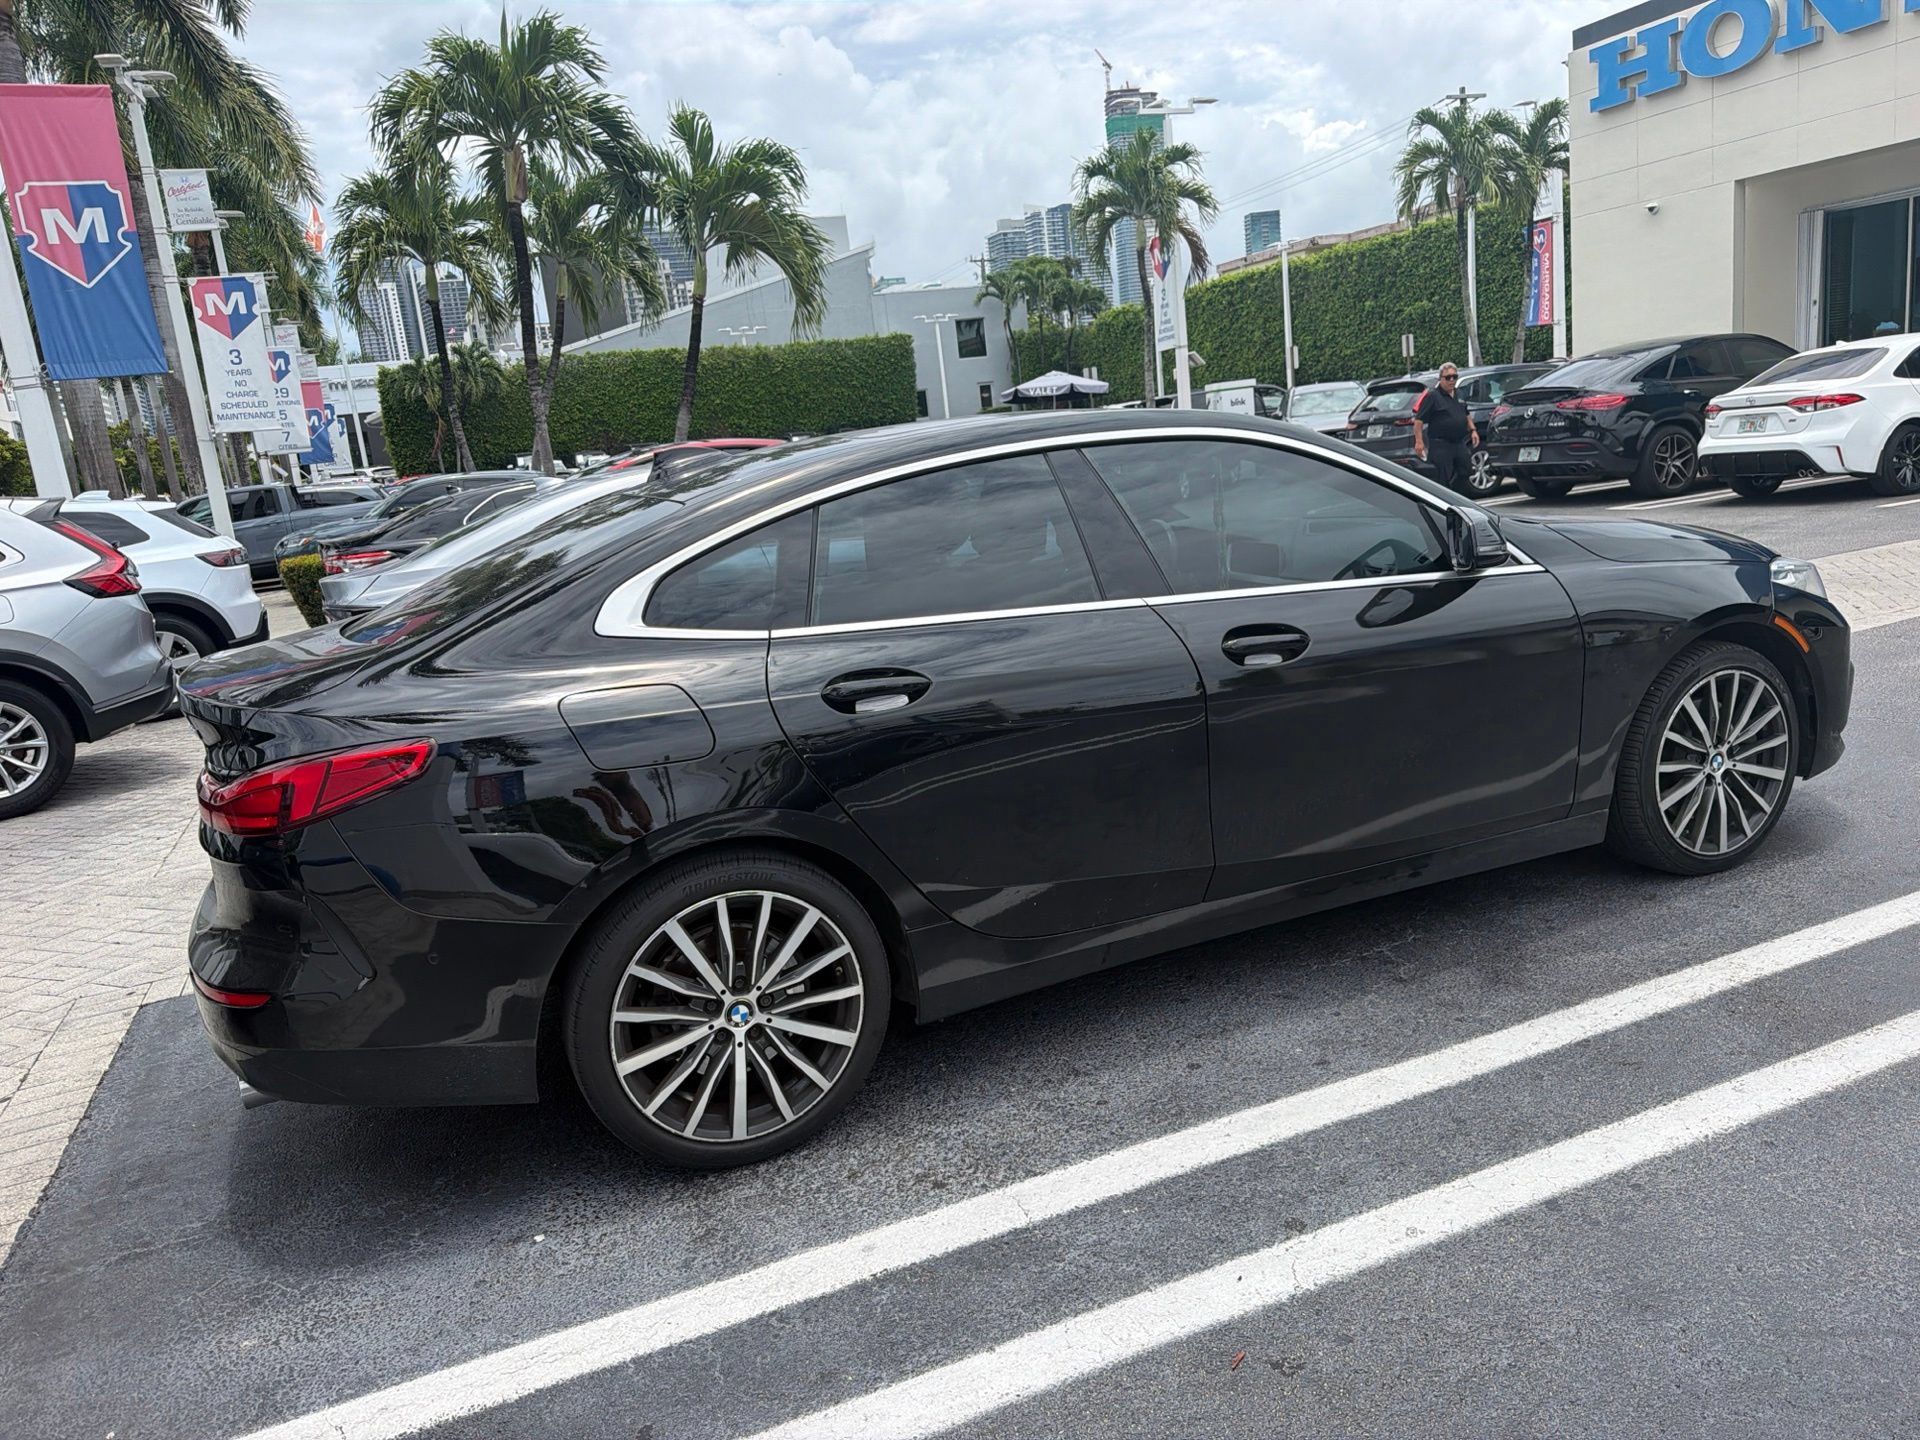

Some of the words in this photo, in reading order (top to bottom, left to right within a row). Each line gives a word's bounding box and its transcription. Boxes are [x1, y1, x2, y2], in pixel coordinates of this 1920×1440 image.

[1588, 0, 1920, 113] HON
[41, 207, 110, 244] M
[204, 291, 248, 317] M
[229, 349, 243, 366] 3
[225, 368, 253, 377] YEARS
[234, 379, 248, 388] NO
[226, 390, 260, 399] CHARGE
[1028, 386, 1058, 395] VALET
[220, 400, 269, 410] SCHEDULED
[216, 410, 277, 421] MAINTENANCE
[281, 431, 291, 442] 7
[682, 871, 778, 897] BRIDGESTONE
